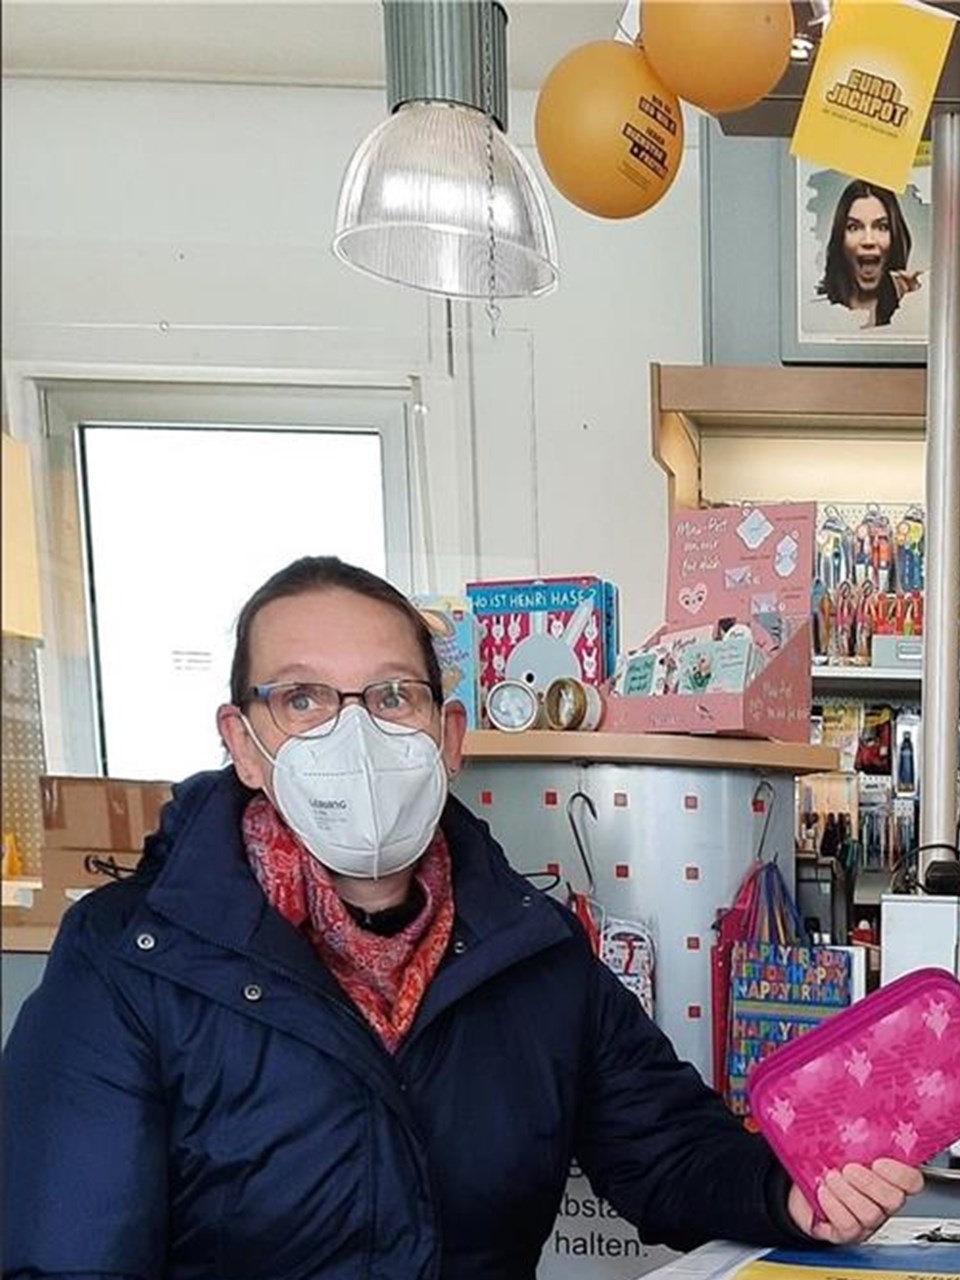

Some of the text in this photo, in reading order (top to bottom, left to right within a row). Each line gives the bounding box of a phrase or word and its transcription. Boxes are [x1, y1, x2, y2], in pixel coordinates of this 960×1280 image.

[847, 69, 903, 104] EURO
[826, 82, 910, 127] JACKPOT
[556, 1230, 649, 1257] halten.
